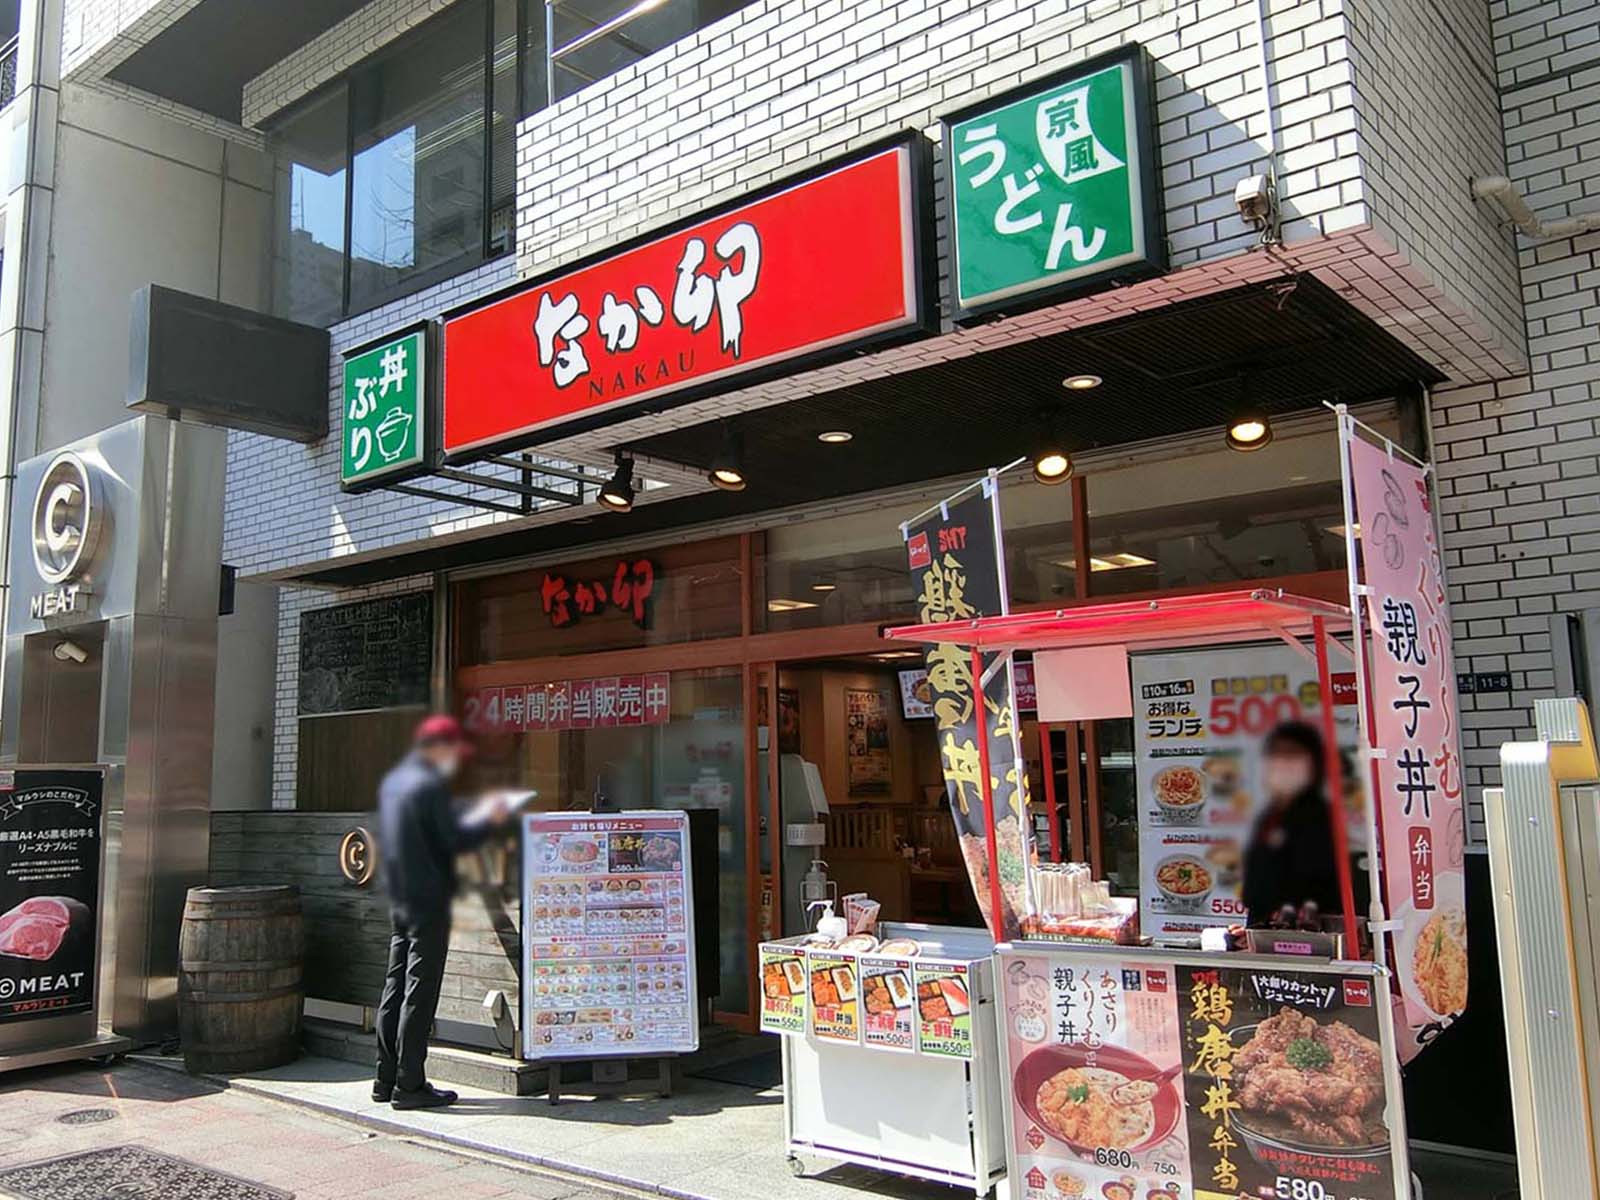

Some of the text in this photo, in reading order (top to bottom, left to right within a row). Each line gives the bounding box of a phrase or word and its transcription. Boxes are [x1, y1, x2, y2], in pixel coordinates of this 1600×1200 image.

[1045, 98, 1099, 178] 京風
[959, 123, 1107, 270] うどん
[534, 222, 761, 389] なか卯
[588, 348, 696, 399] NAKAU
[31, 585, 81, 618] MEAT
[541, 560, 654, 625] なか卯
[465, 686, 668, 726] 24時間弁当販売中
[1149, 701, 1191, 716] お得な
[1149, 719, 1202, 737] ランチ
[1384, 598, 1436, 818] 親子丼
[1411, 833, 1432, 901] 弁当
[1211, 898, 1246, 915] 550
[20, 972, 84, 994] MEAT
[1053, 967, 1078, 1044] 親子丼
[1100, 971, 1118, 1033] あさり
